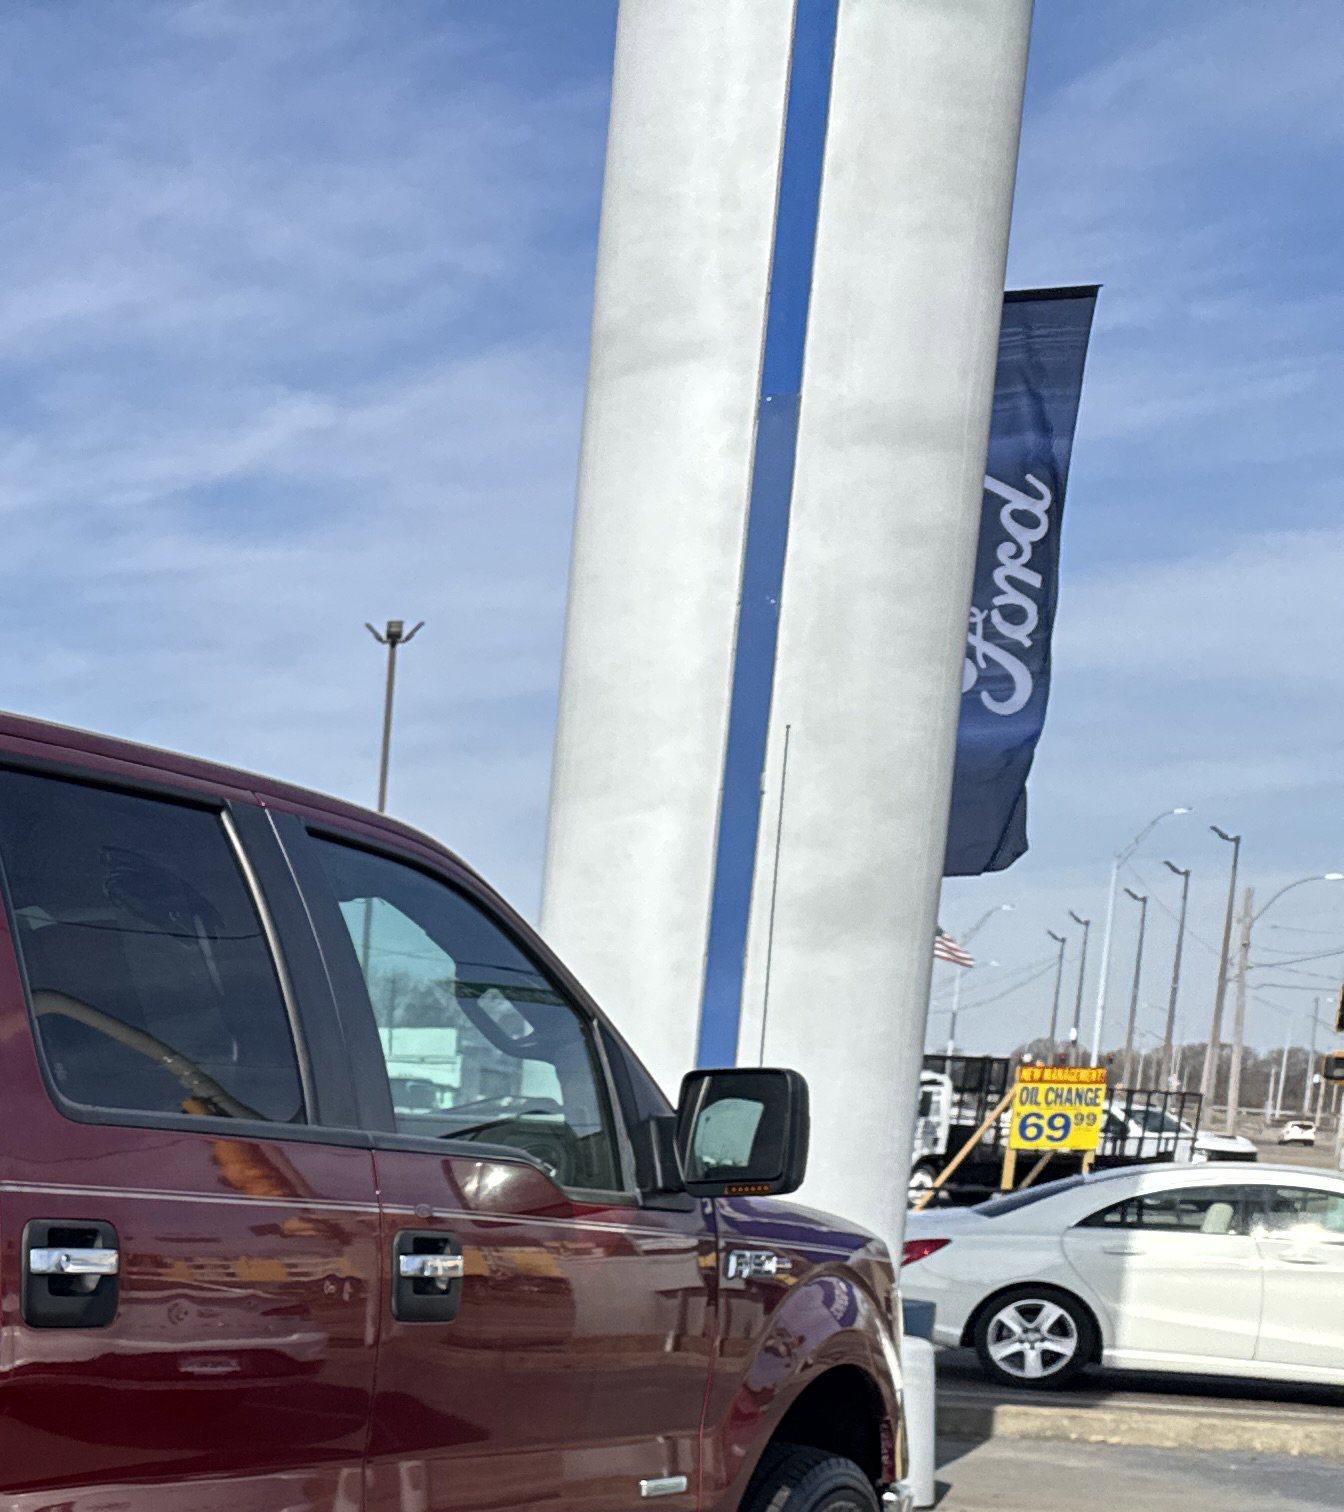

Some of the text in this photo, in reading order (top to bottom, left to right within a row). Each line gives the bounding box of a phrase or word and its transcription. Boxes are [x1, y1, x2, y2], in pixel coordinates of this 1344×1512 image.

[962, 473, 1052, 716] Ford
[1018, 1086, 1102, 1107] OIL CHANGE
